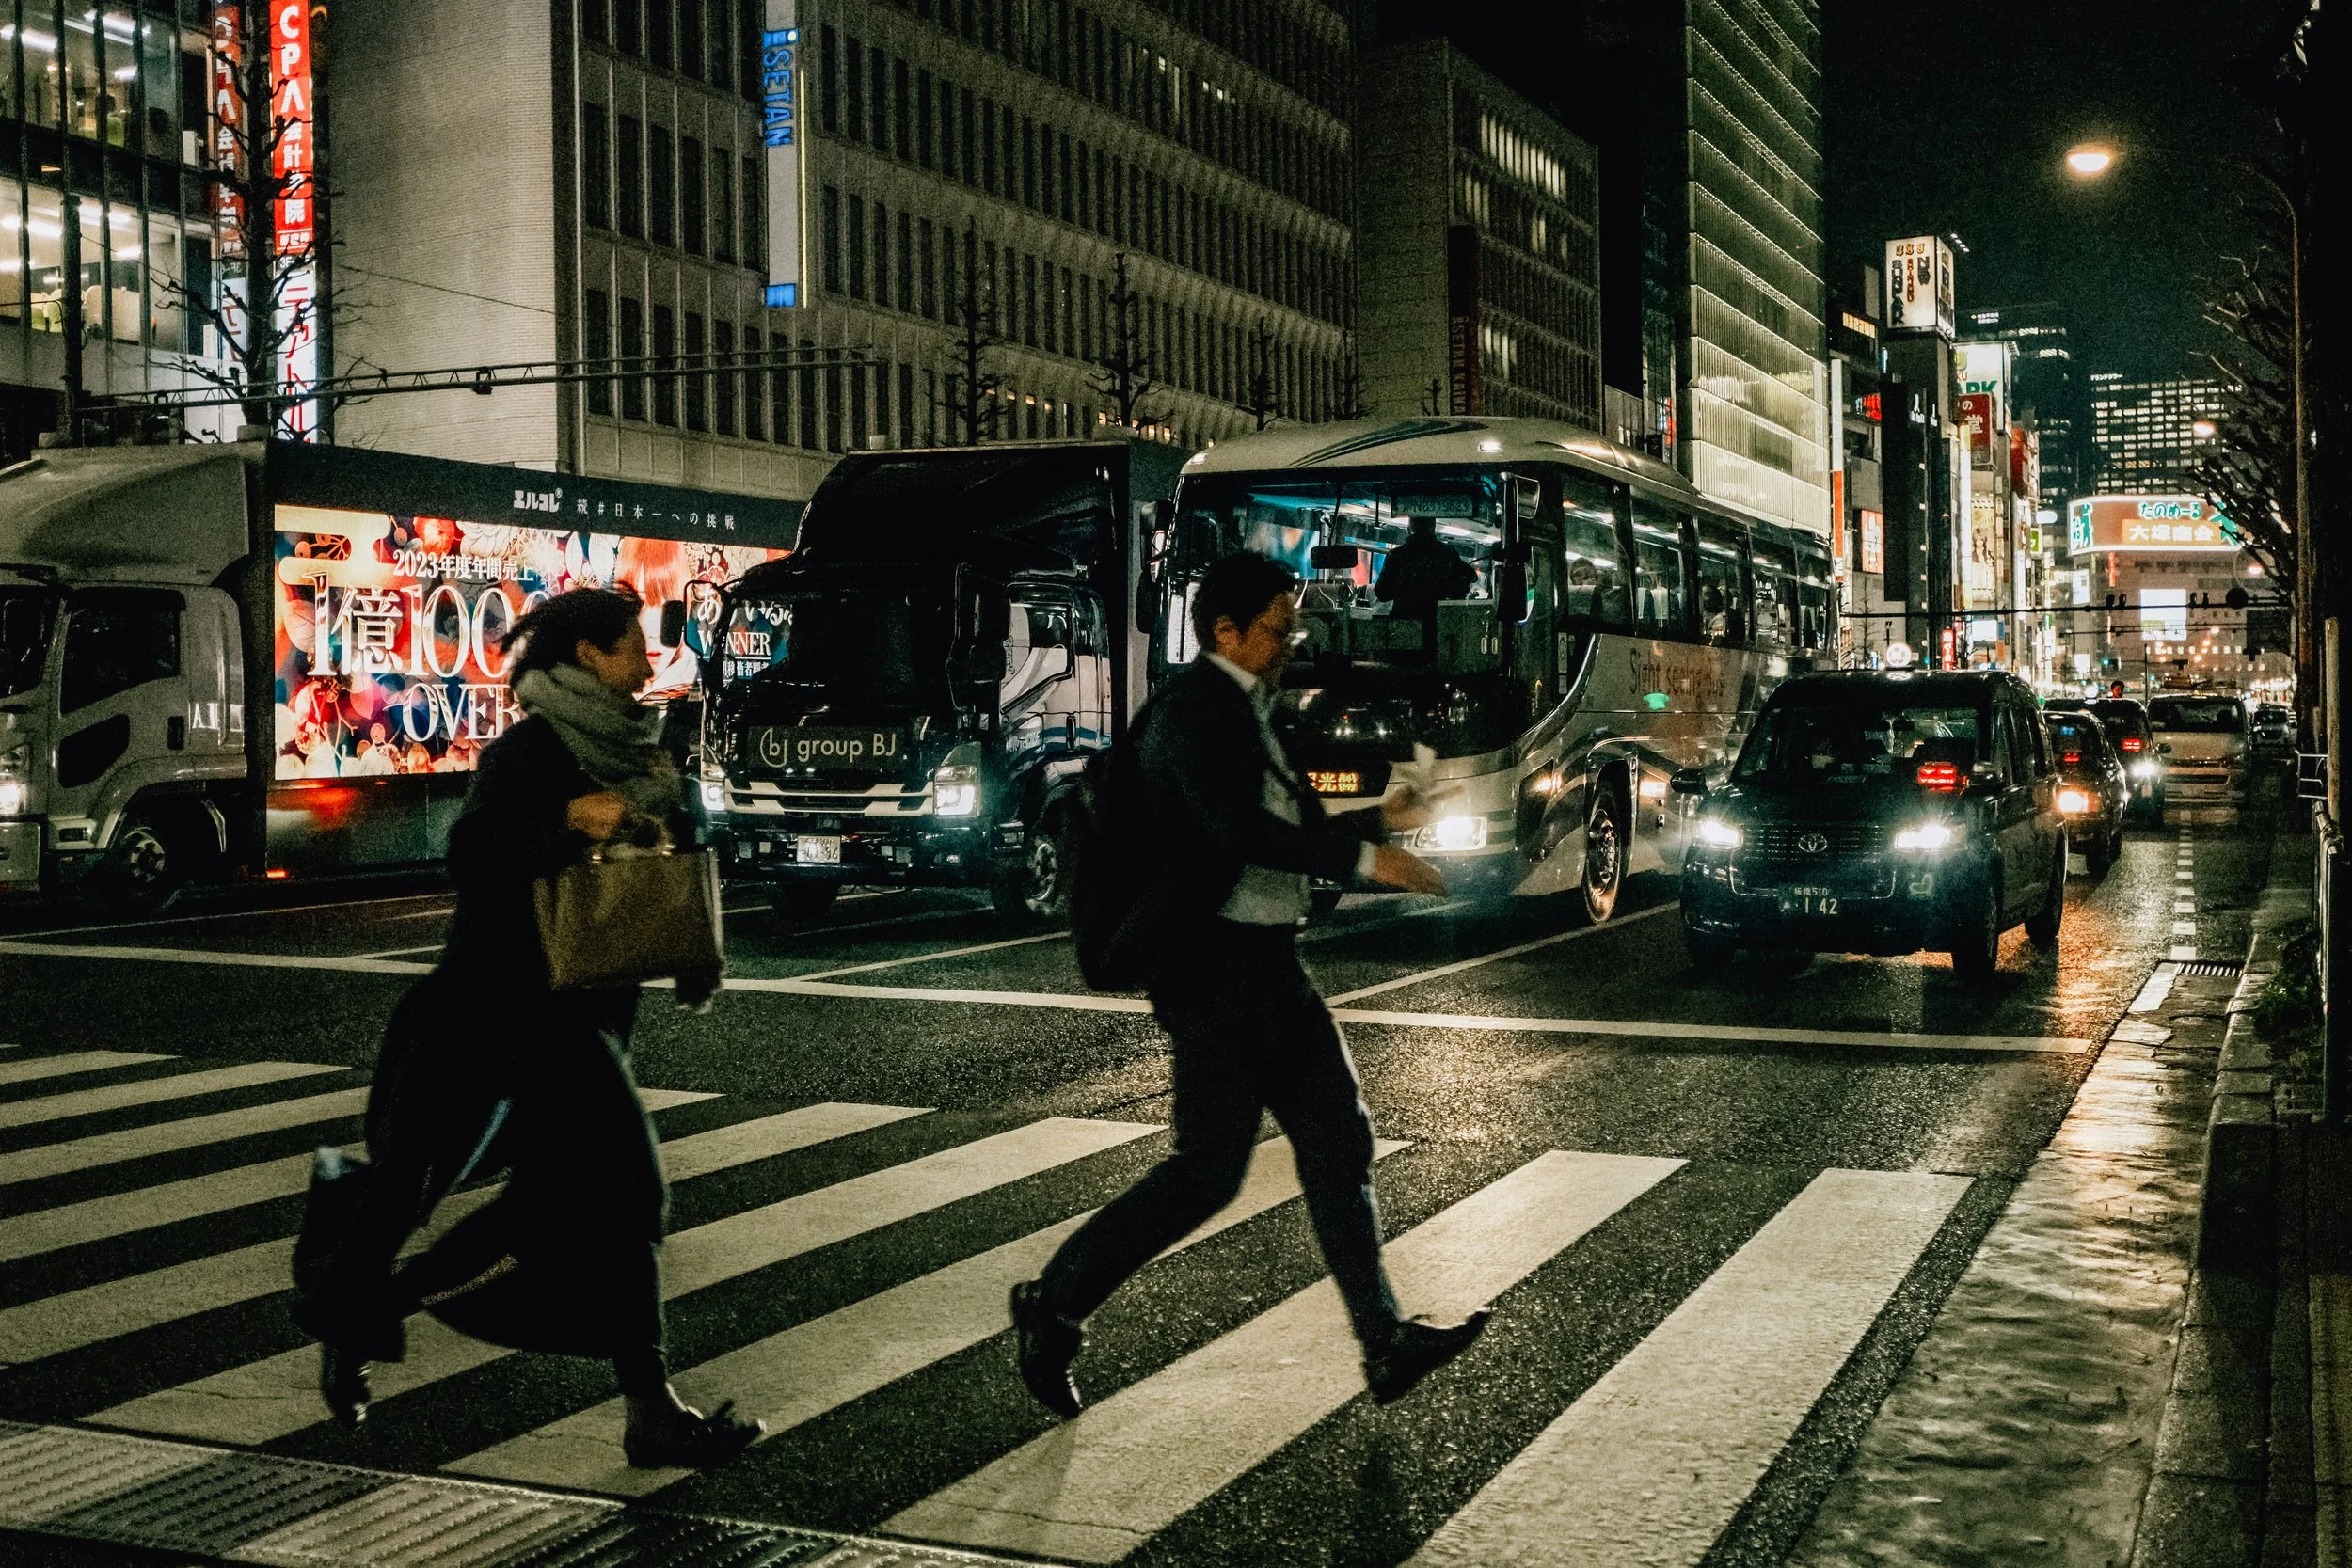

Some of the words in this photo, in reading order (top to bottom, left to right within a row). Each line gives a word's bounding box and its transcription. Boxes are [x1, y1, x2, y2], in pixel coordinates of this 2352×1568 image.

[2139, 502, 2202, 518] たのめーる
[392, 548, 534, 582] 2023年度年間売上
[302, 570, 549, 678] 1億100
[697, 630, 771, 657] WNNER
[797, 739, 863, 763] group
[872, 733, 896, 756] BJ
[1819, 897, 1838, 915] 42
